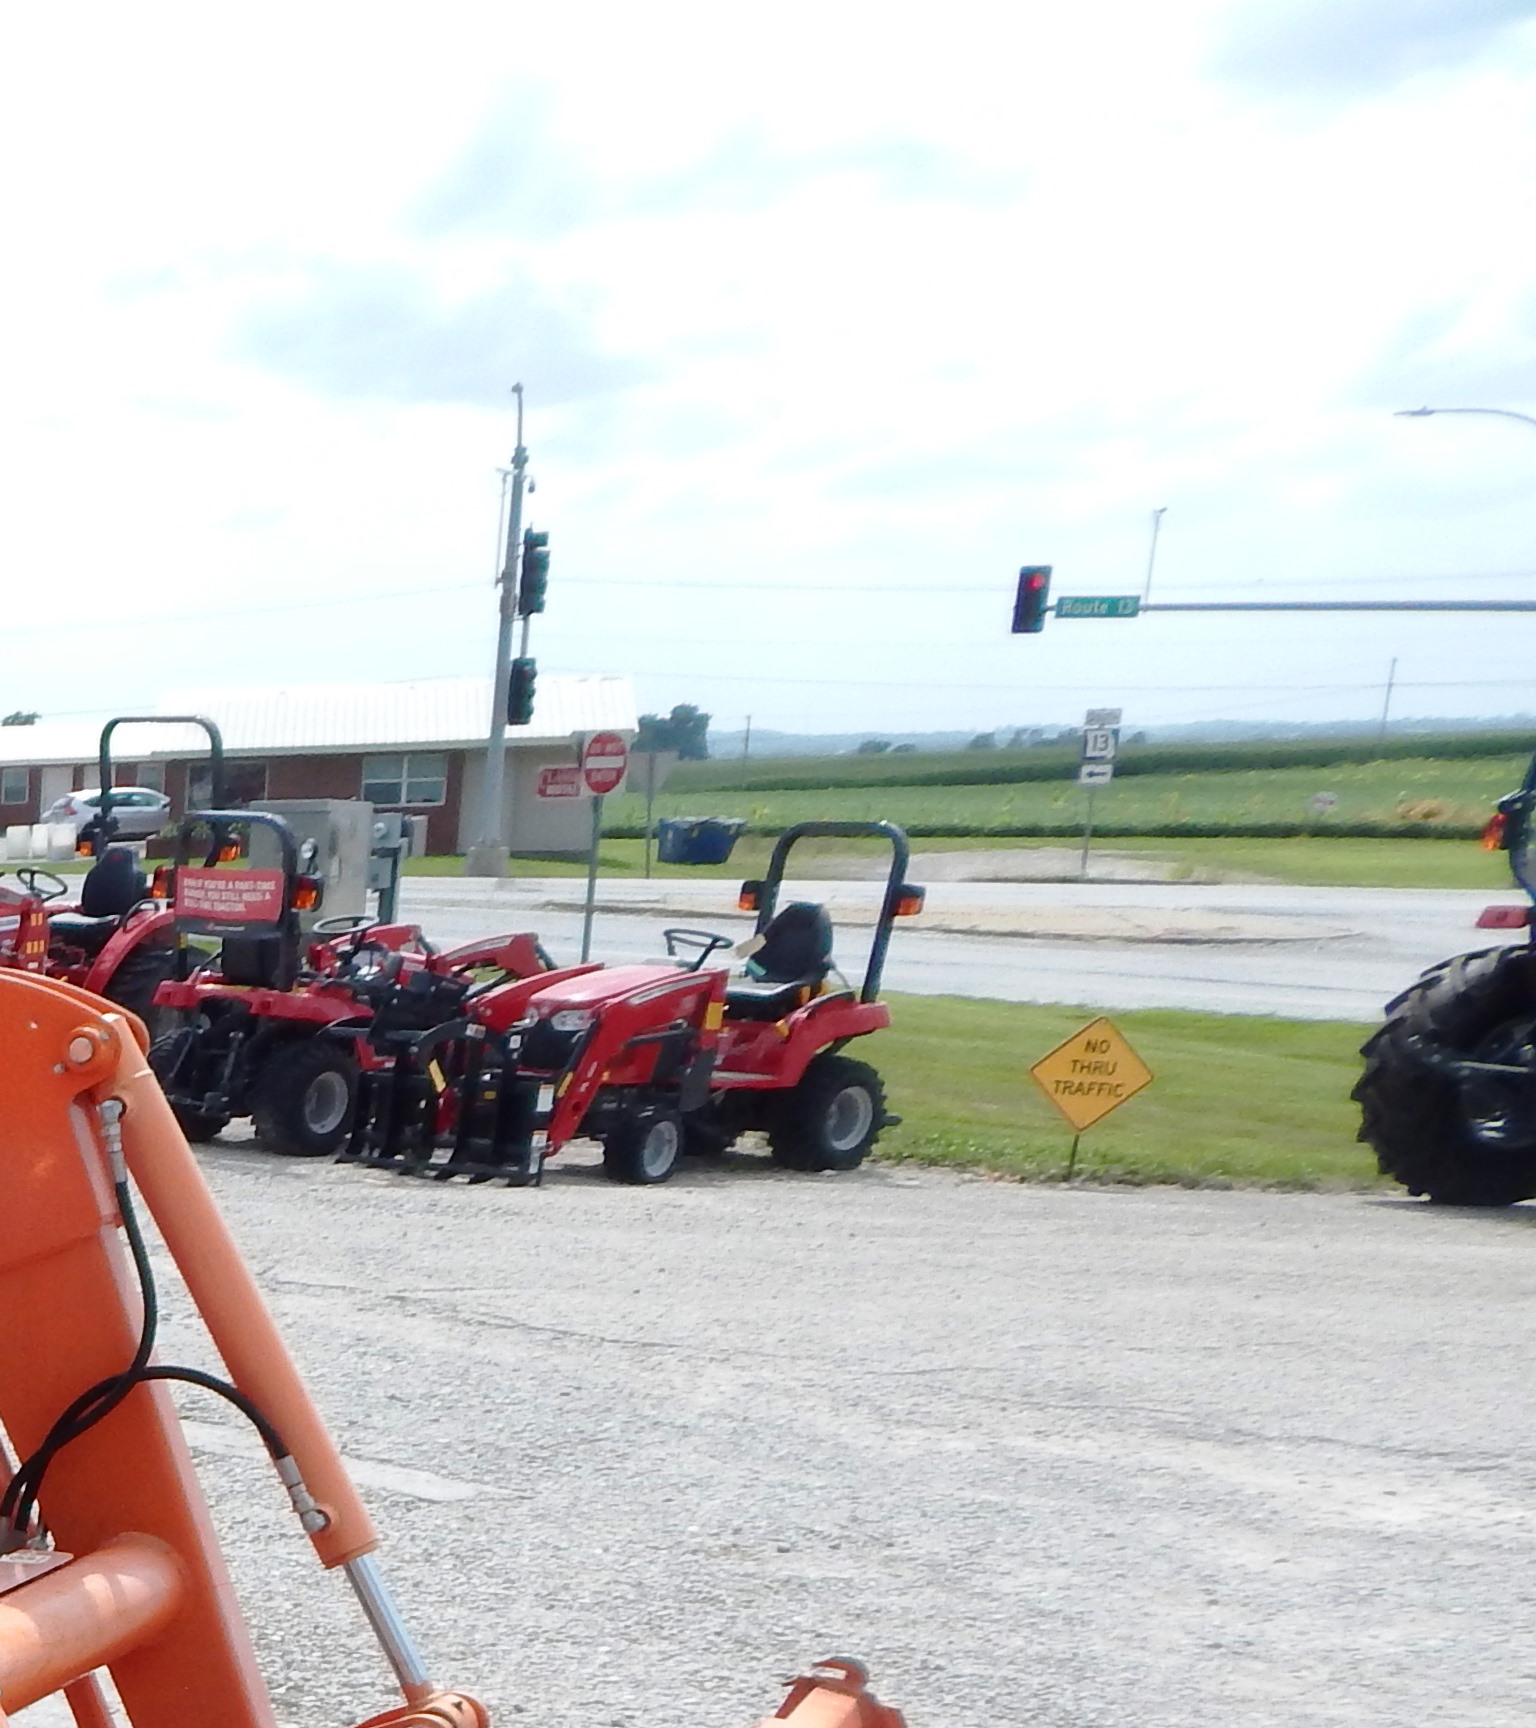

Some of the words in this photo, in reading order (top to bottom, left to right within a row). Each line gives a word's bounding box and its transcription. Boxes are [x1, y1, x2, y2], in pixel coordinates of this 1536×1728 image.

[1062, 600, 1109, 615] Route
[1093, 734, 1109, 752] 13
[1084, 1039, 1111, 1054] NO
[1071, 1059, 1118, 1076] THRU
[1054, 1080, 1126, 1098] TRAFFIC
